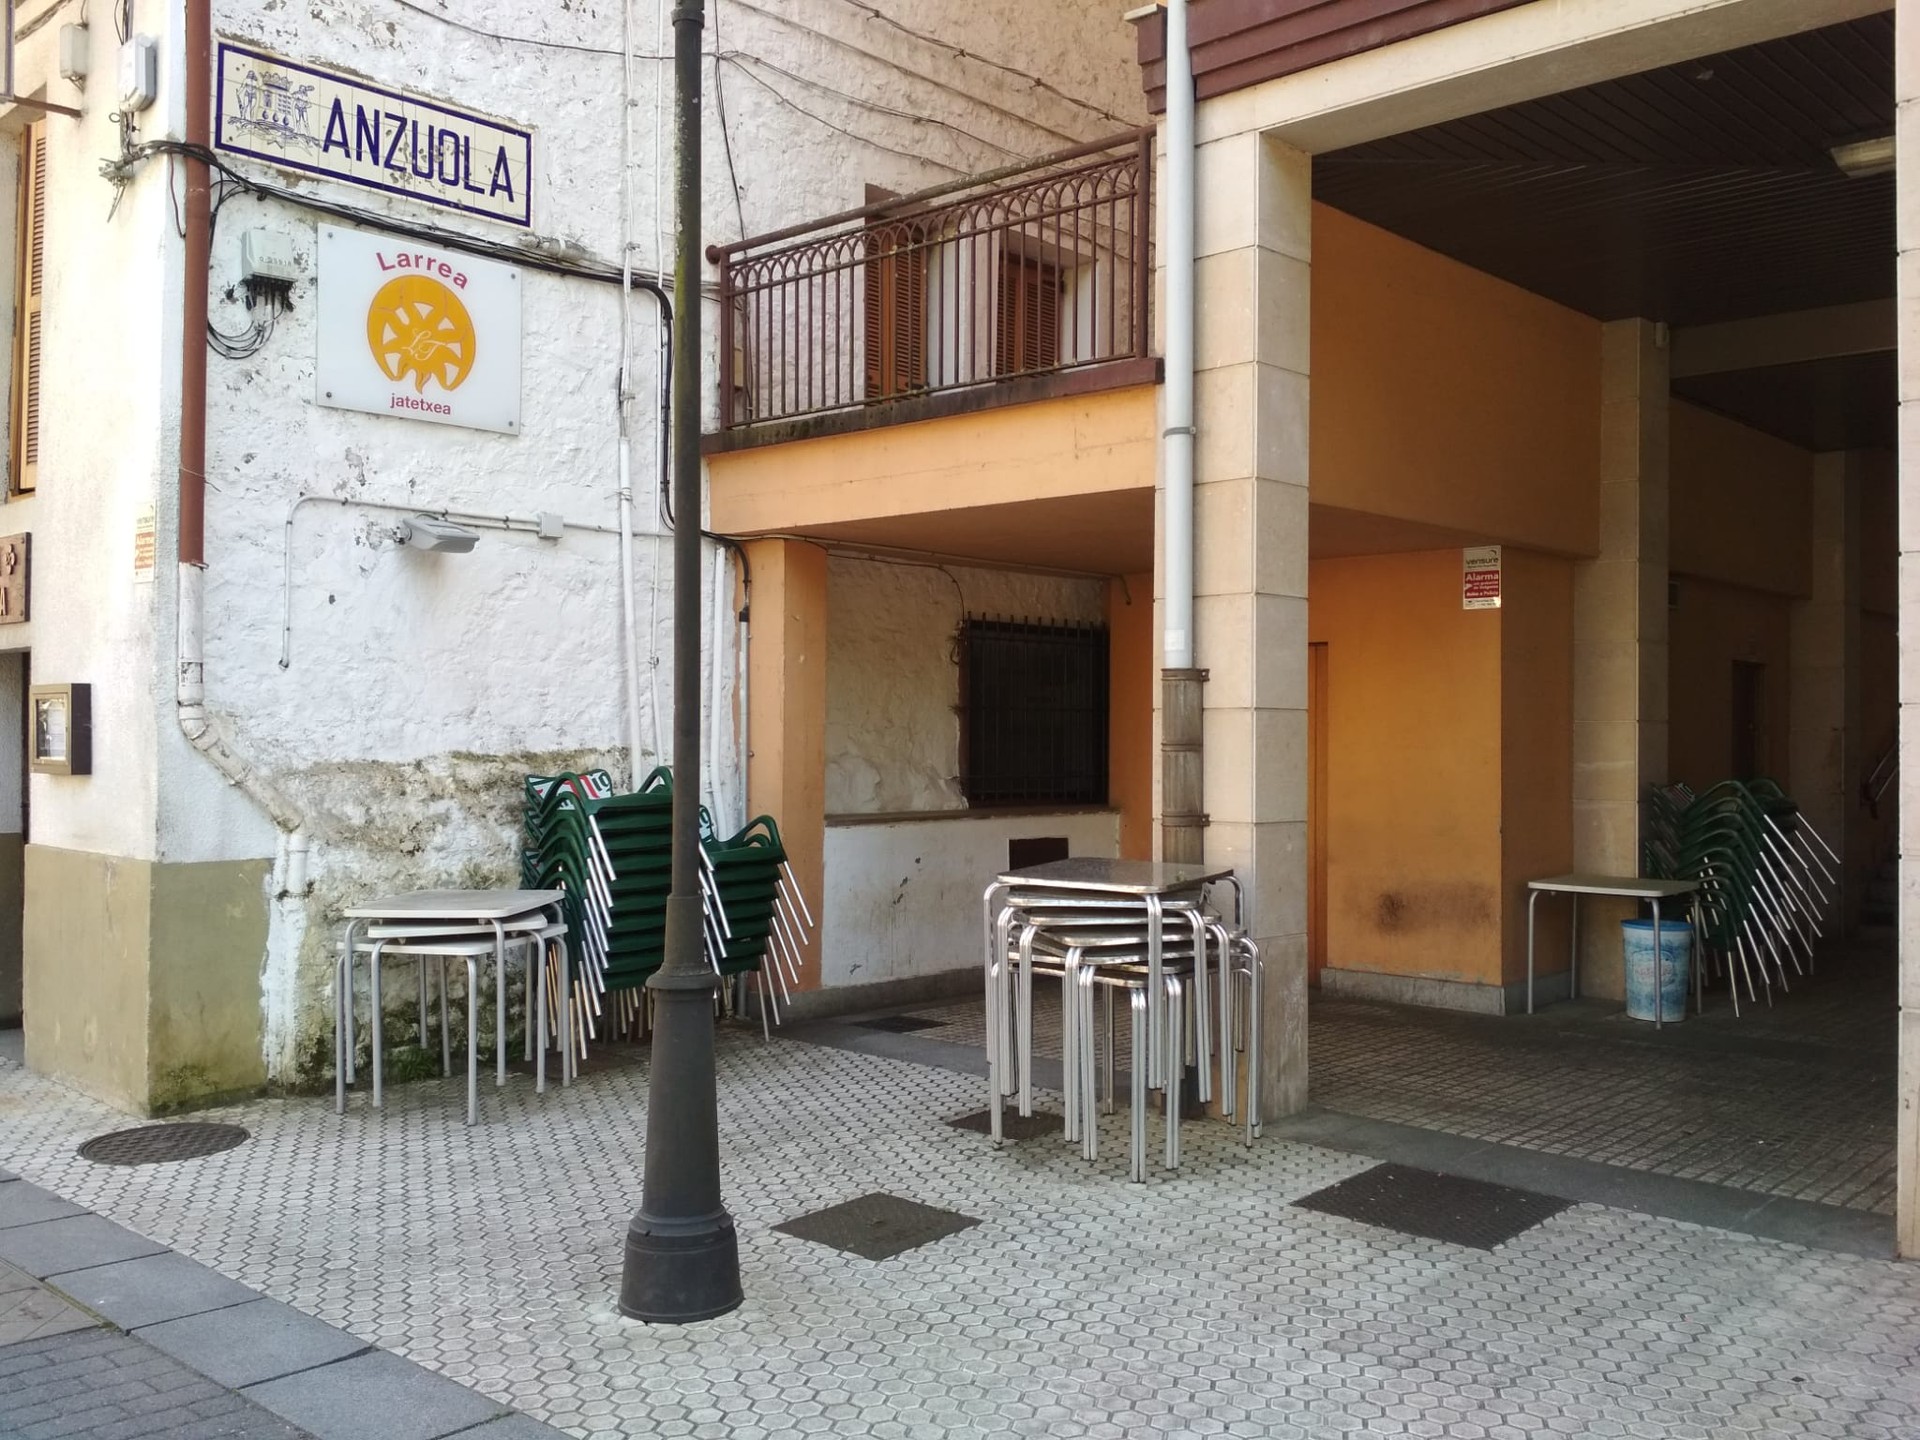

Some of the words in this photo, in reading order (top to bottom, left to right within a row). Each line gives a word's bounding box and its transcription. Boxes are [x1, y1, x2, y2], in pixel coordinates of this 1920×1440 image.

[322, 97, 514, 203] ANZUOLA
[376, 251, 468, 289] Larrea
[390, 393, 451, 415] jatetxea
[1465, 573, 1499, 581] Alarma
